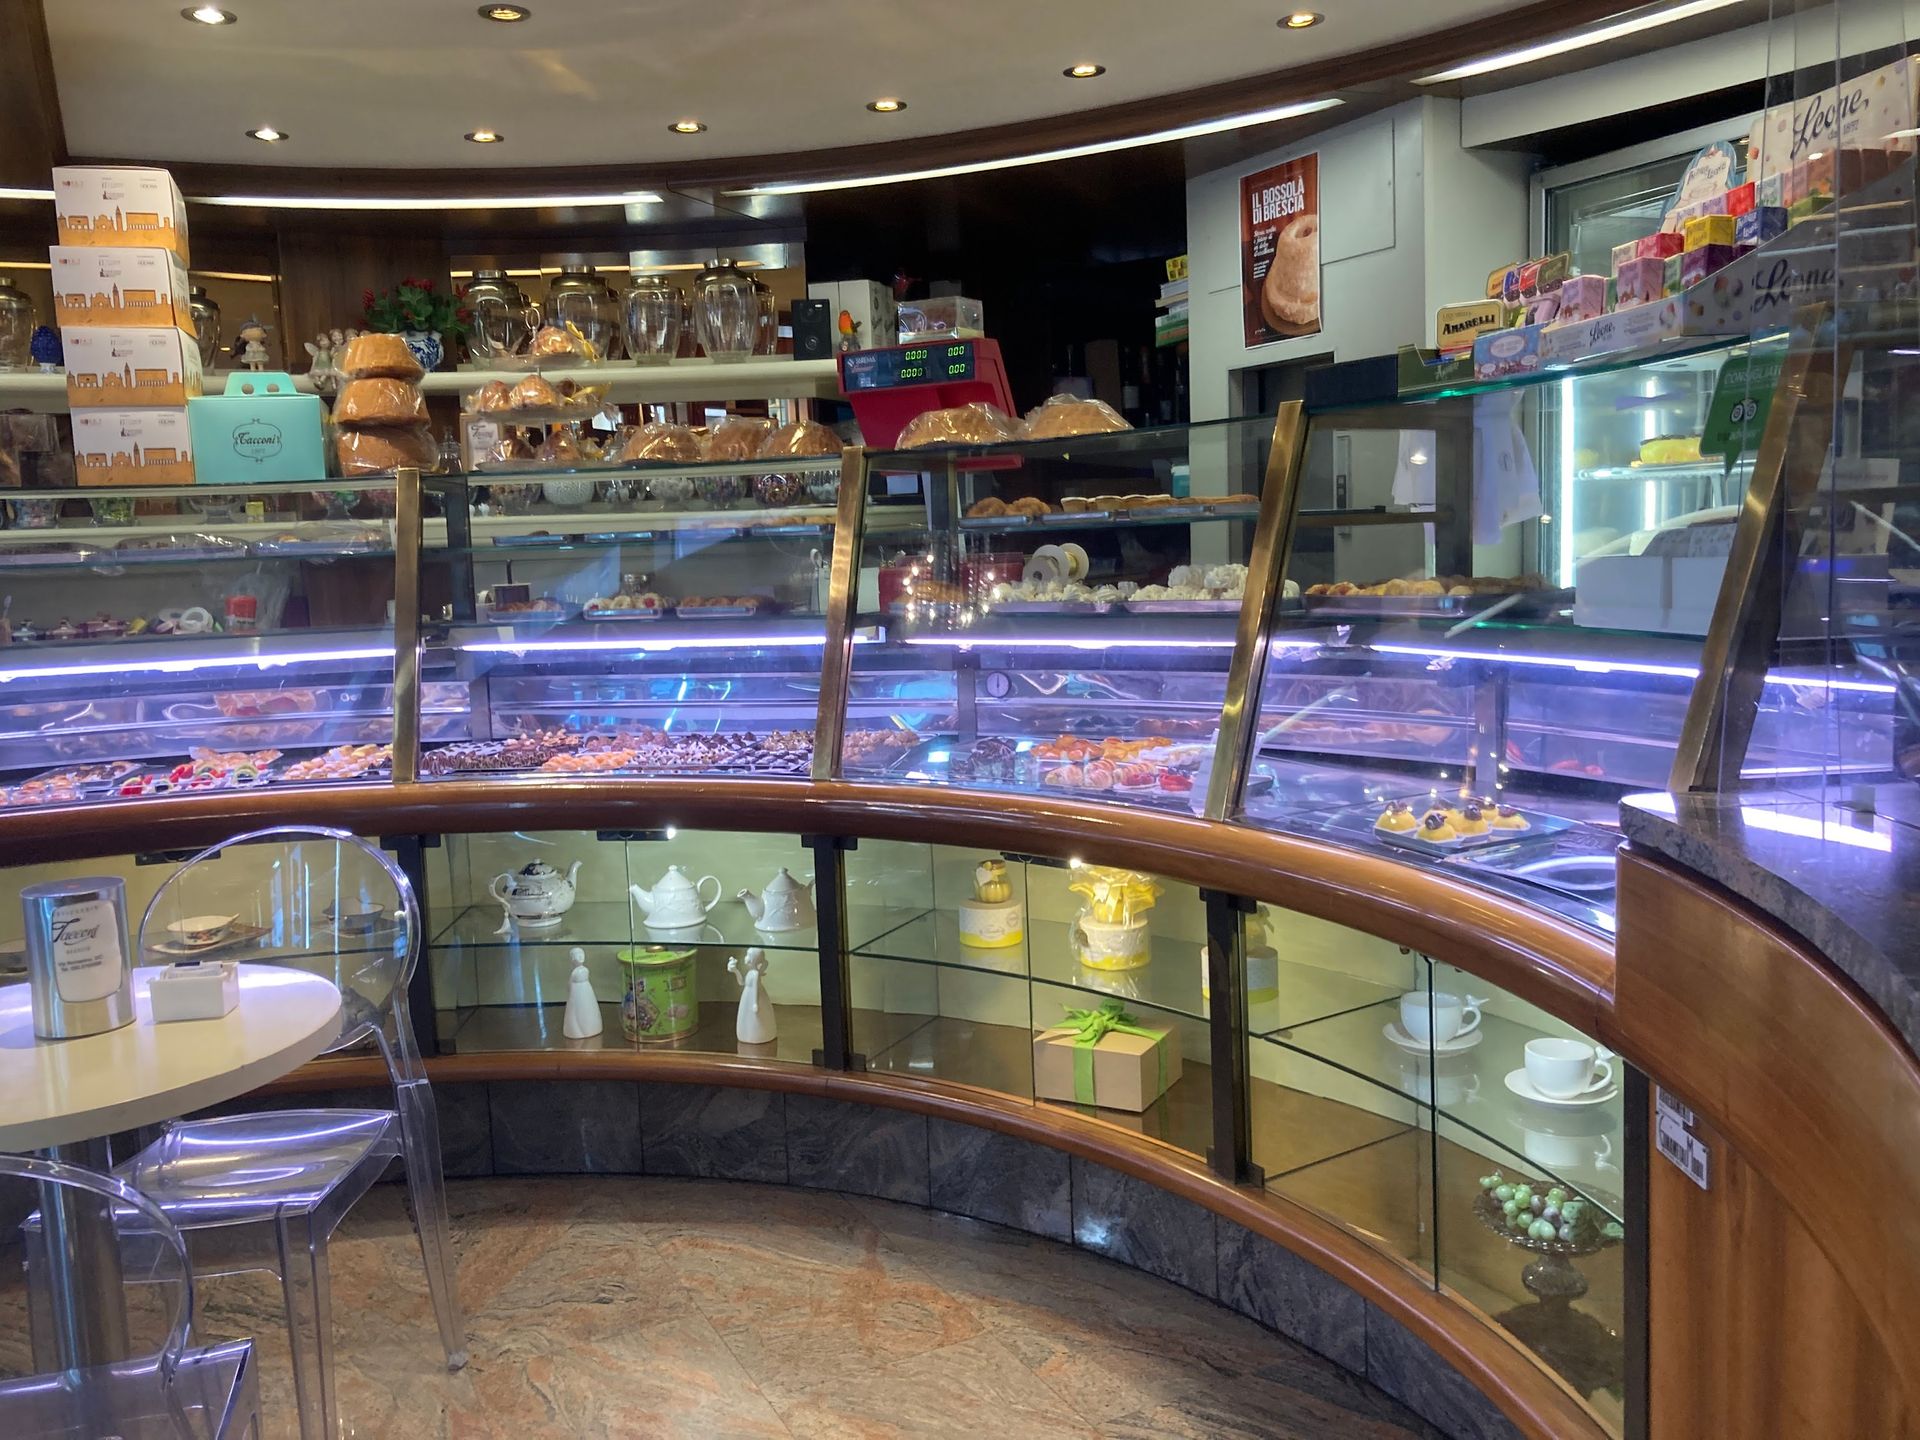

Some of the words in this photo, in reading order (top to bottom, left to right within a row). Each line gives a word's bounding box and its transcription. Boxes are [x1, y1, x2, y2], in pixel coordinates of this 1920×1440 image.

[1252, 192, 1261, 208] IL
[1263, 175, 1304, 206] BOSSOLÀ
[1252, 208, 1262, 224] DI
[1263, 194, 1304, 222] BRESCIA
[1442, 314, 1495, 335] AMARELLI
